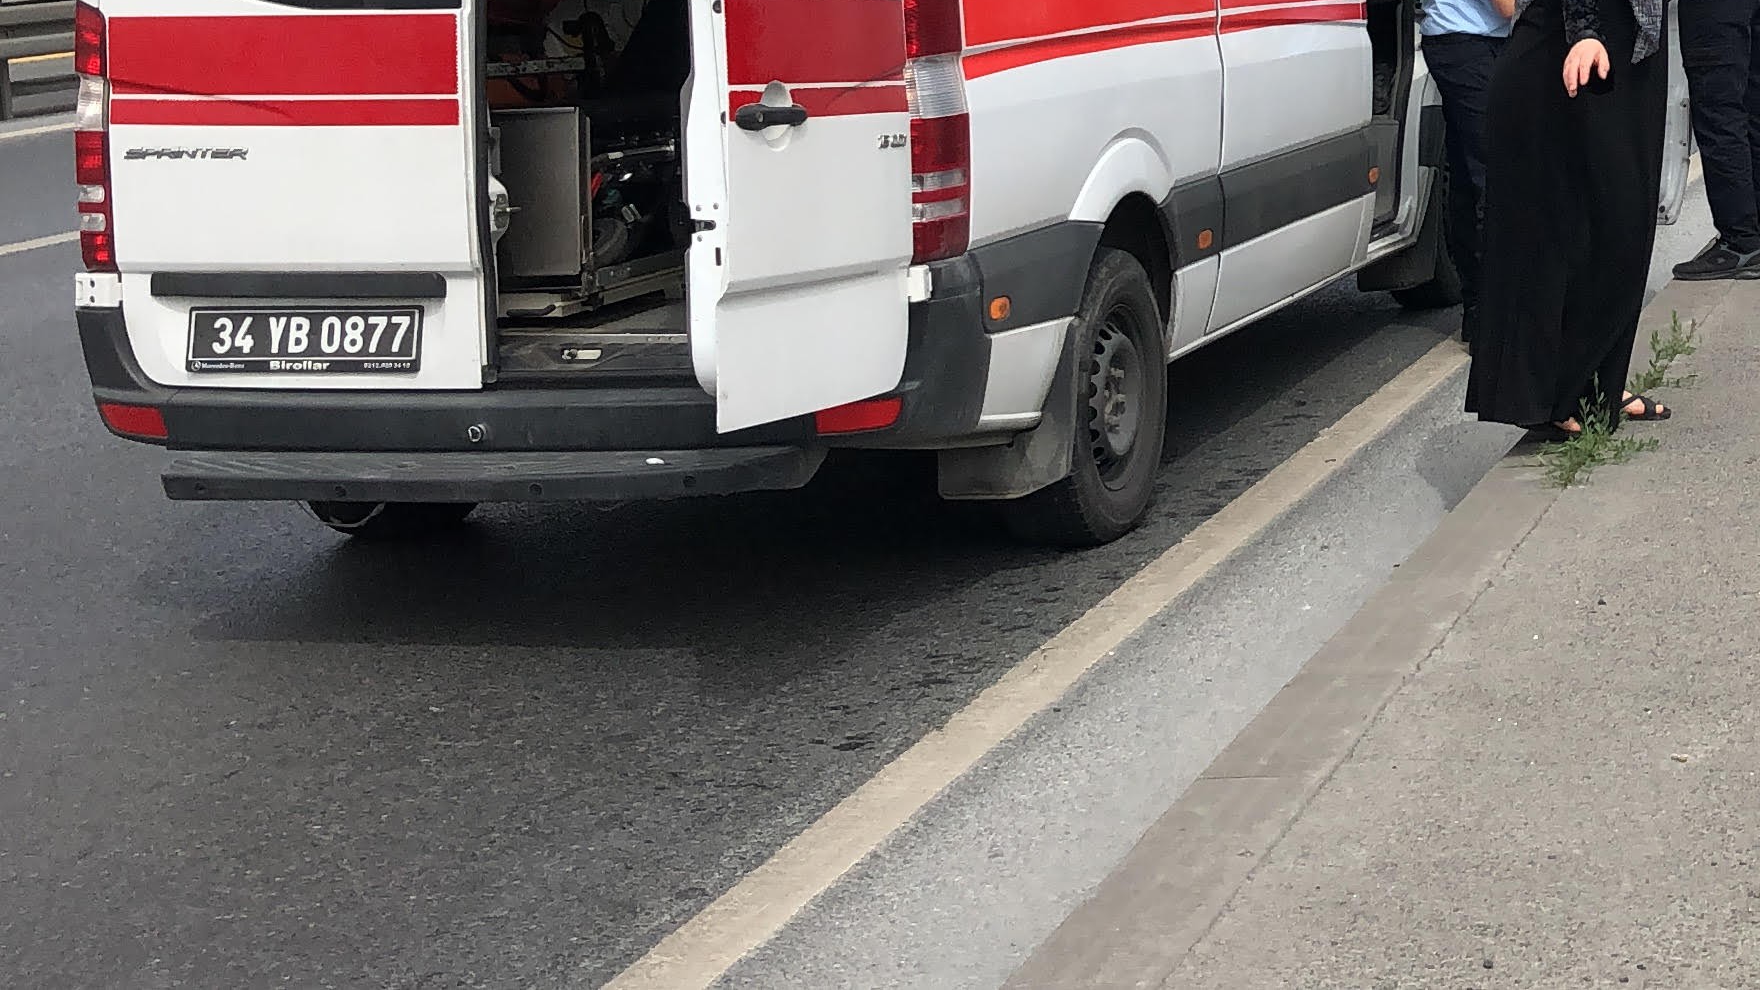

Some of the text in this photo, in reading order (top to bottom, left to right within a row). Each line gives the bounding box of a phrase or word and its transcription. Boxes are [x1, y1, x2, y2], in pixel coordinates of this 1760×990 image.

[124, 148, 248, 160] SPRINTER
[211, 316, 411, 354] 34 YB 0877
[269, 360, 330, 371] Birollar
